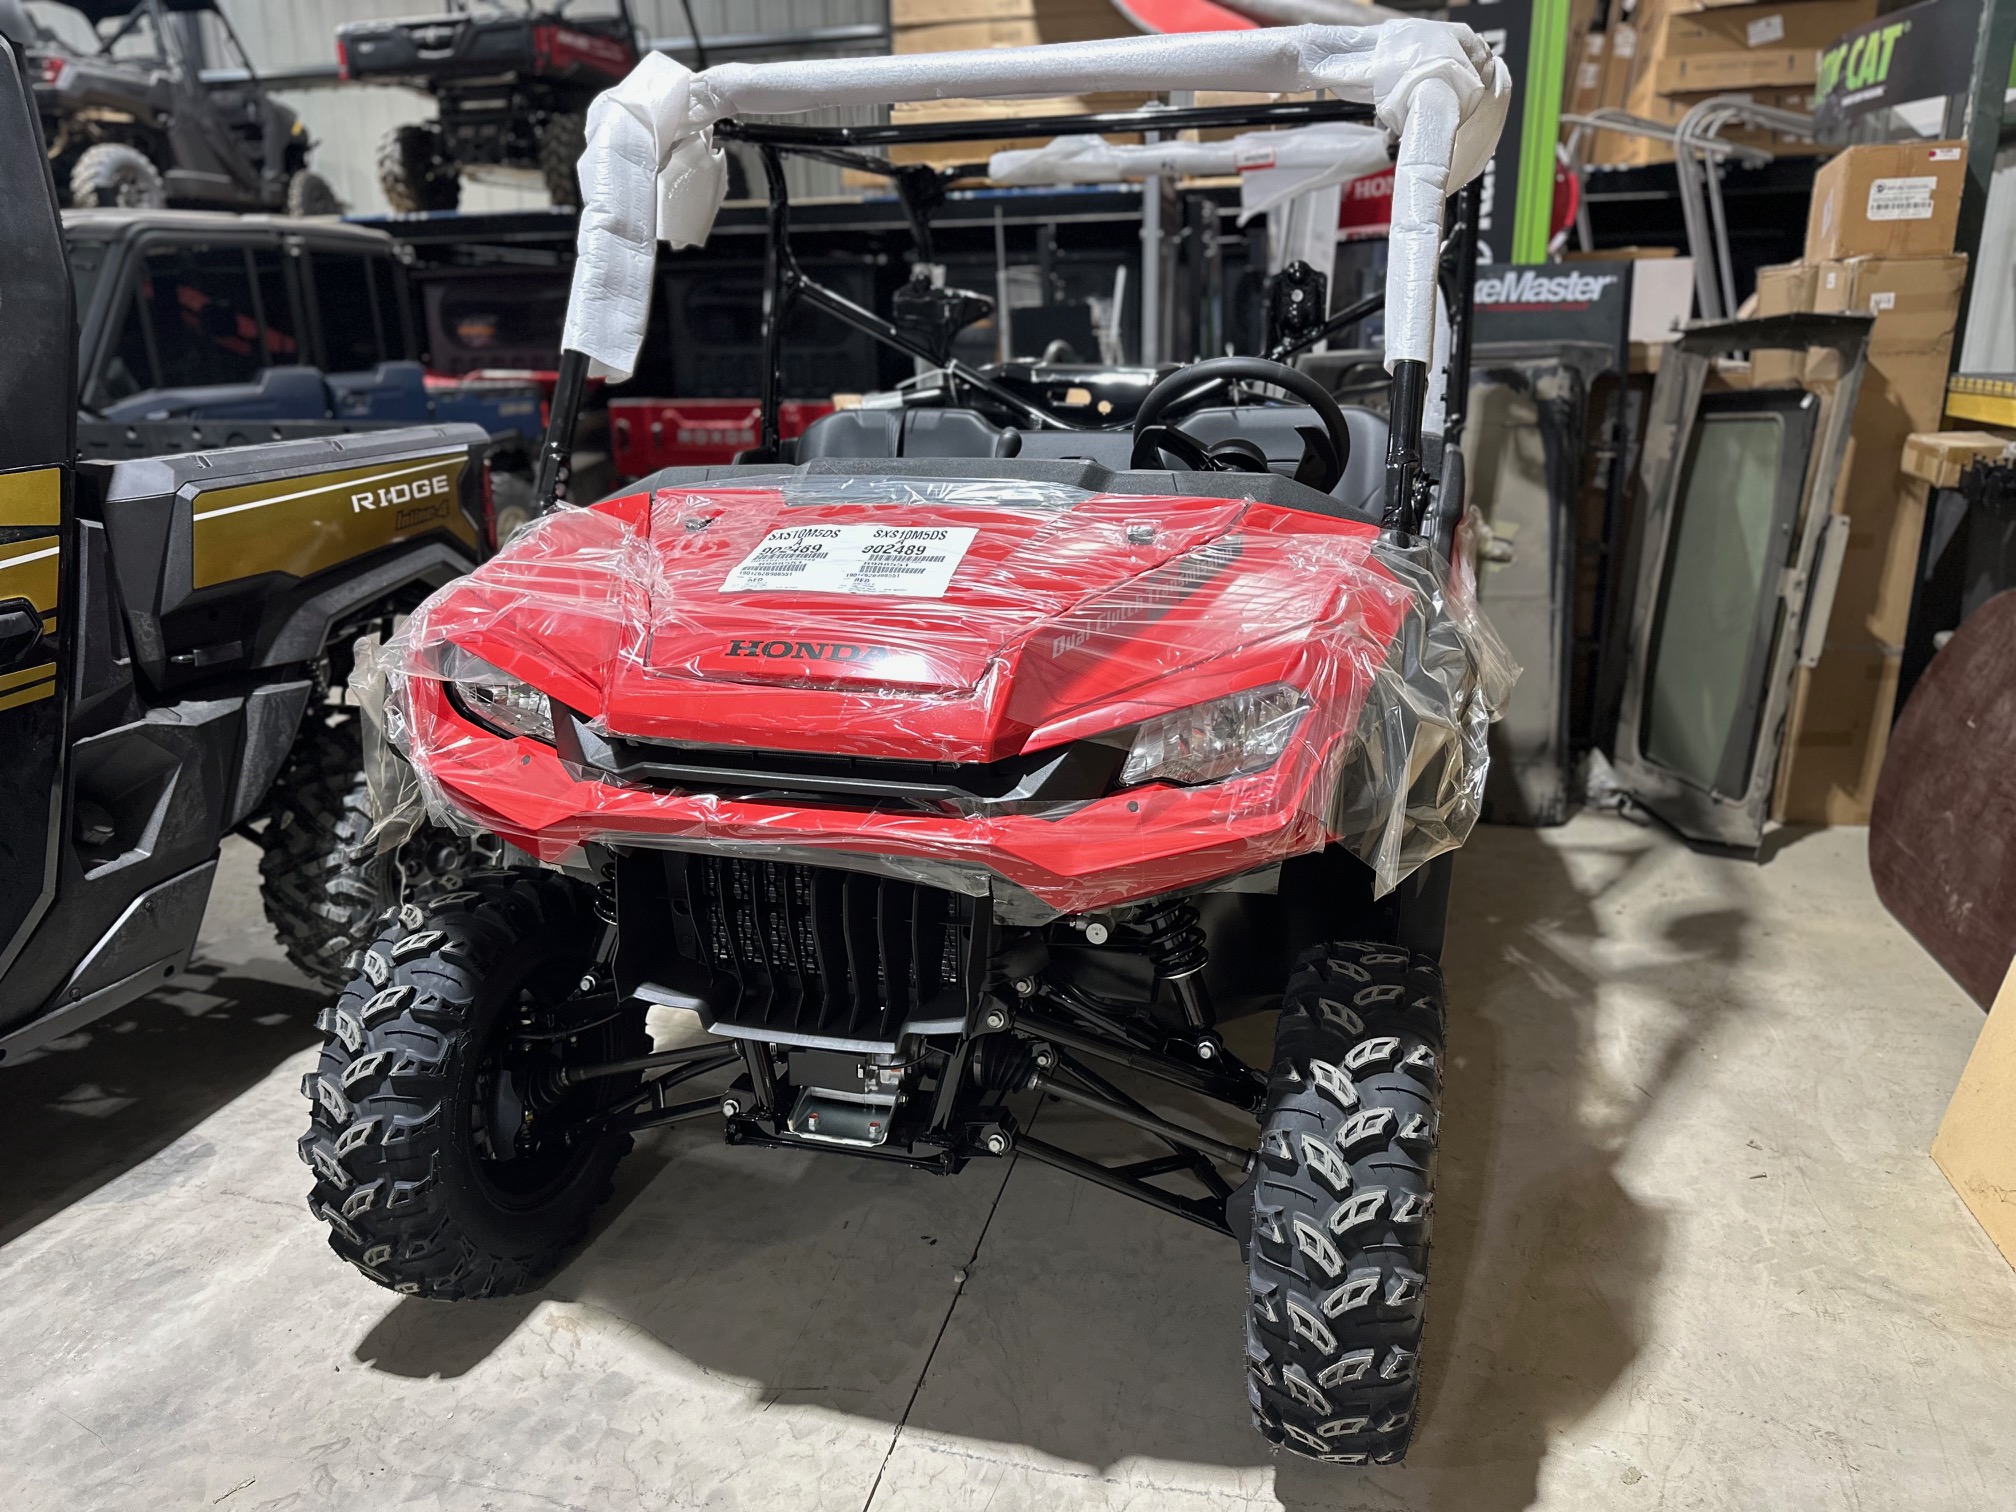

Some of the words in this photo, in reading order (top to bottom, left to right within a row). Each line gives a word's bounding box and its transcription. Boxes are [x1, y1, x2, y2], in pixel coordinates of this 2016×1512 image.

[1845, 22, 1904, 91] CAT
[351, 475, 450, 513] RIDGE
[768, 528, 841, 541] SXS10M5DS
[873, 529, 948, 541] SXS10M5DS
[761, 543, 823, 554] 902489
[861, 544, 927, 556] 902489
[1052, 623, 1092, 660] Dual
[1096, 592, 1144, 633] Clutch
[725, 639, 890, 662] HONDA
